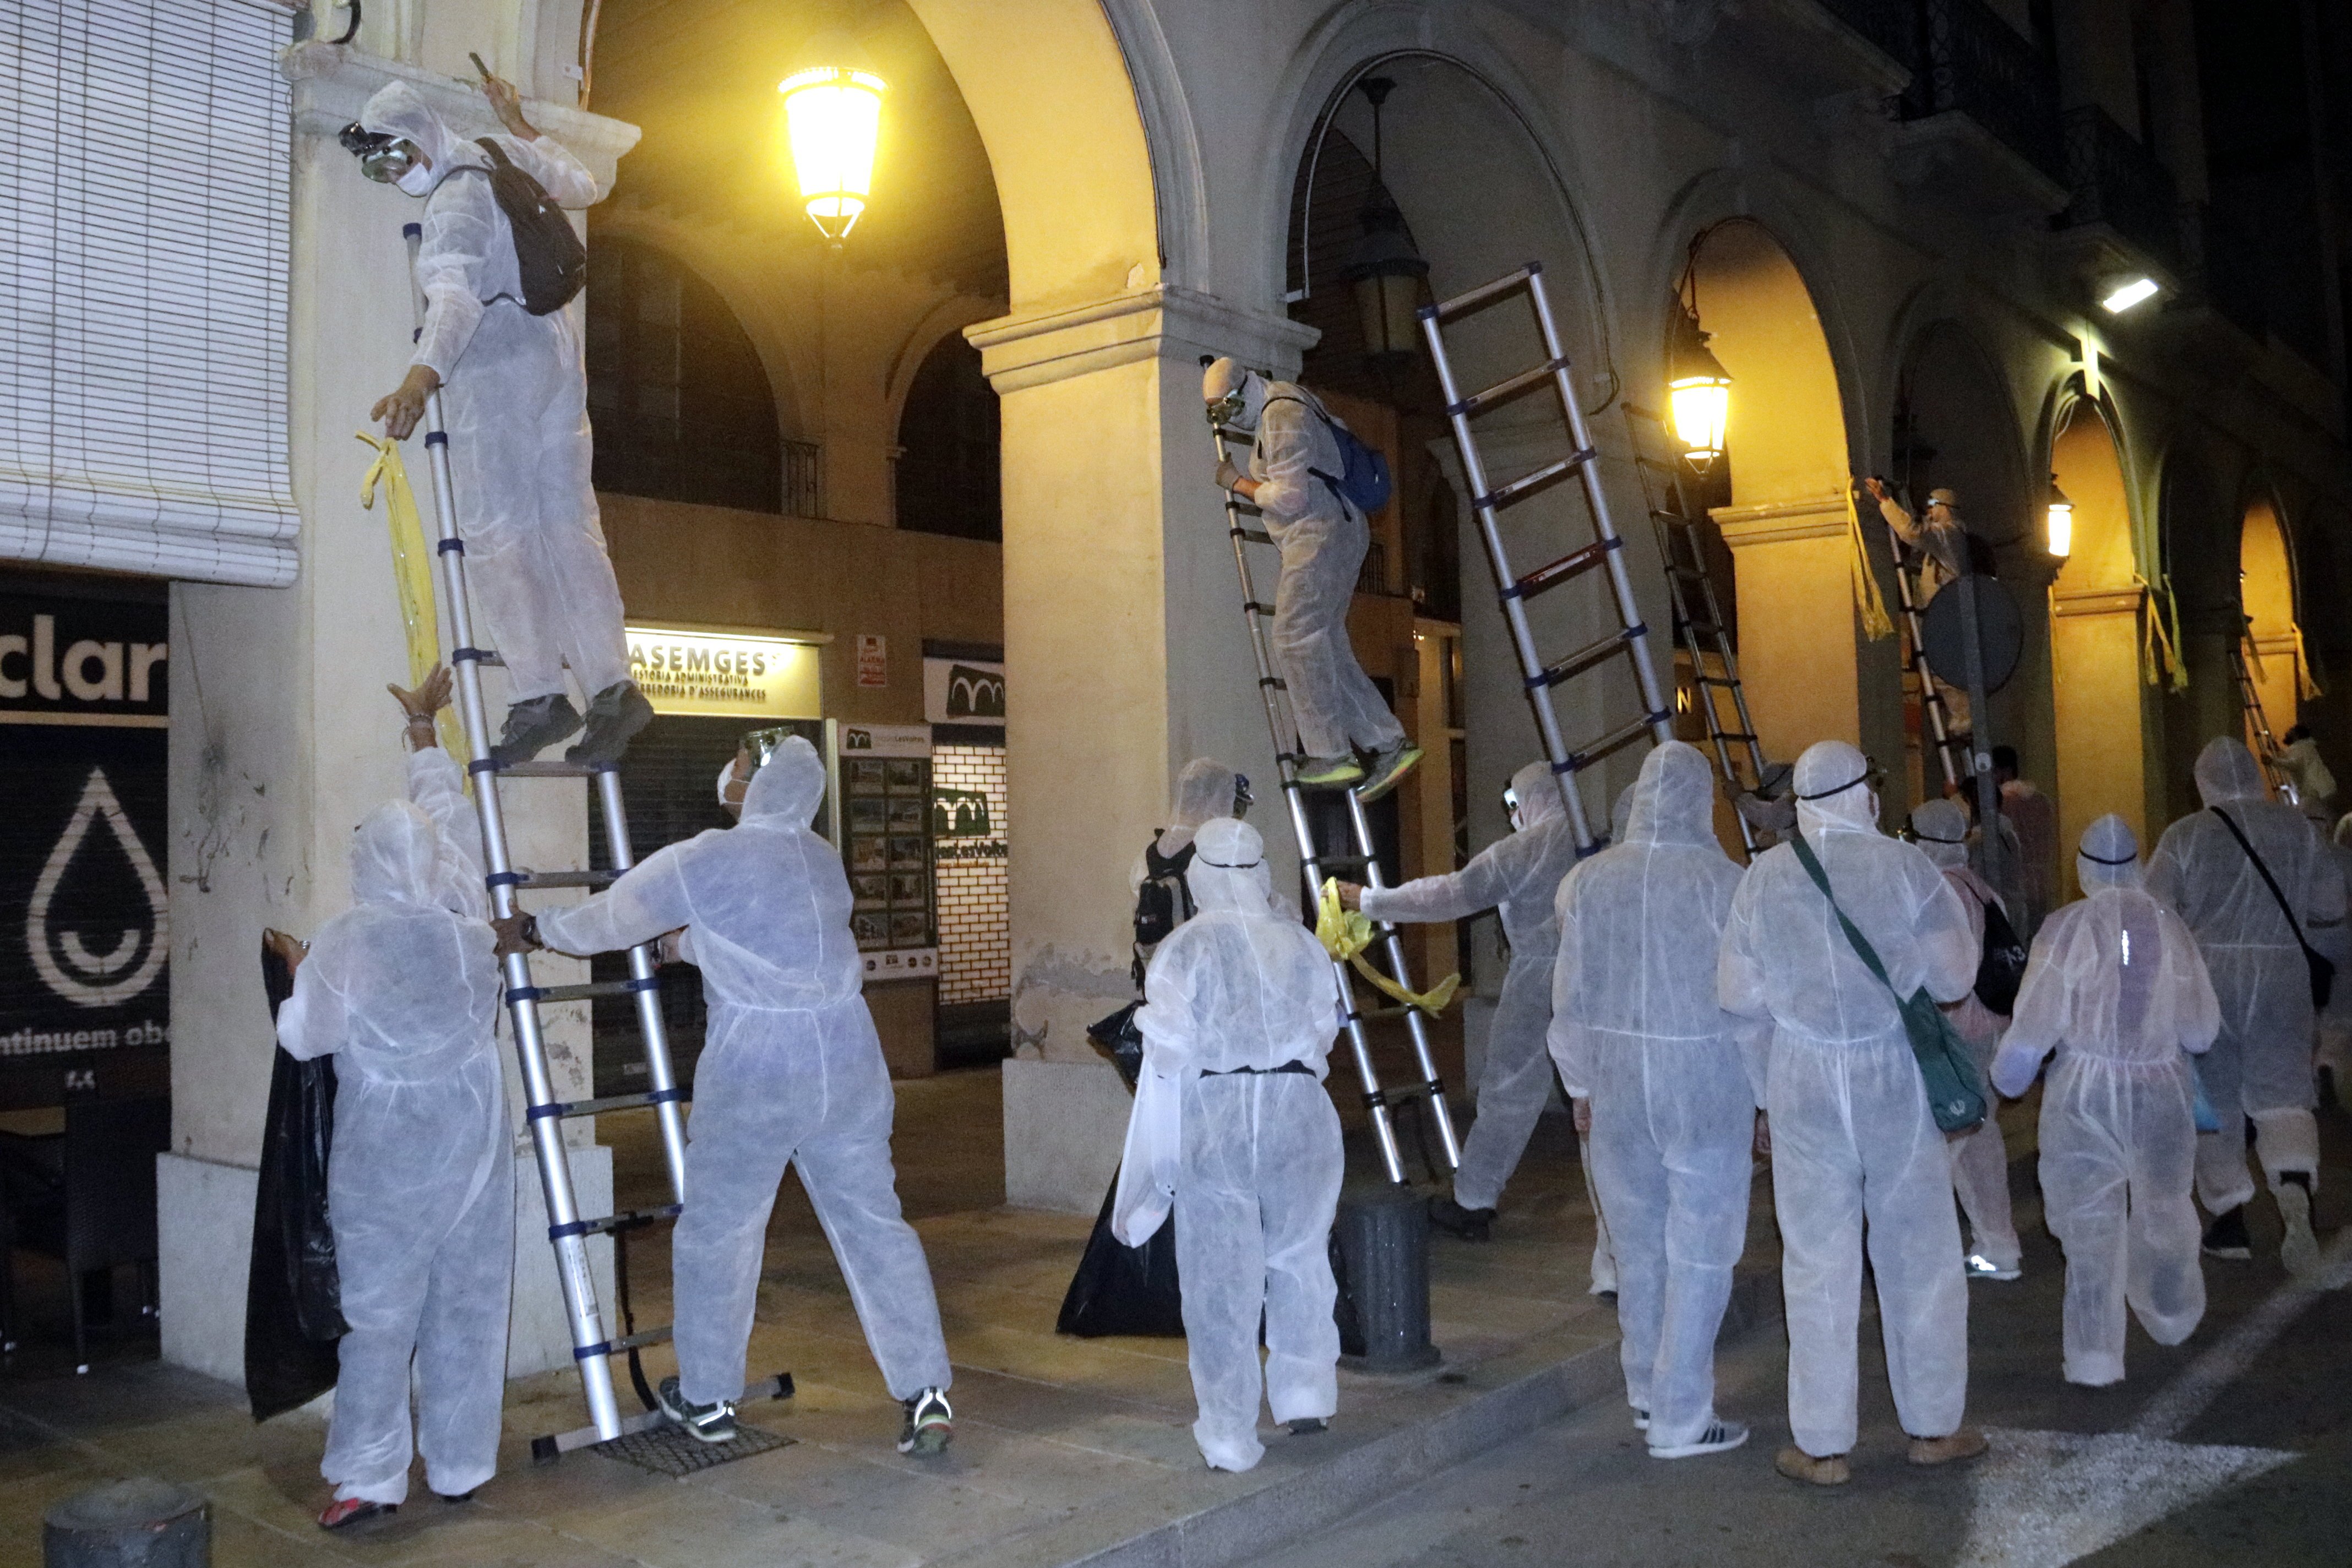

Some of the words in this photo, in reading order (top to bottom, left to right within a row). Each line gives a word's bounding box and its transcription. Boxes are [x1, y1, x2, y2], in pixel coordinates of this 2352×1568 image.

[629, 644, 766, 676] ASEMGES
[674, 672, 749, 687] ADMINISTRATIVA
[689, 686, 766, 701] D'ASSEGURANCES
[1677, 687, 1692, 714] N
